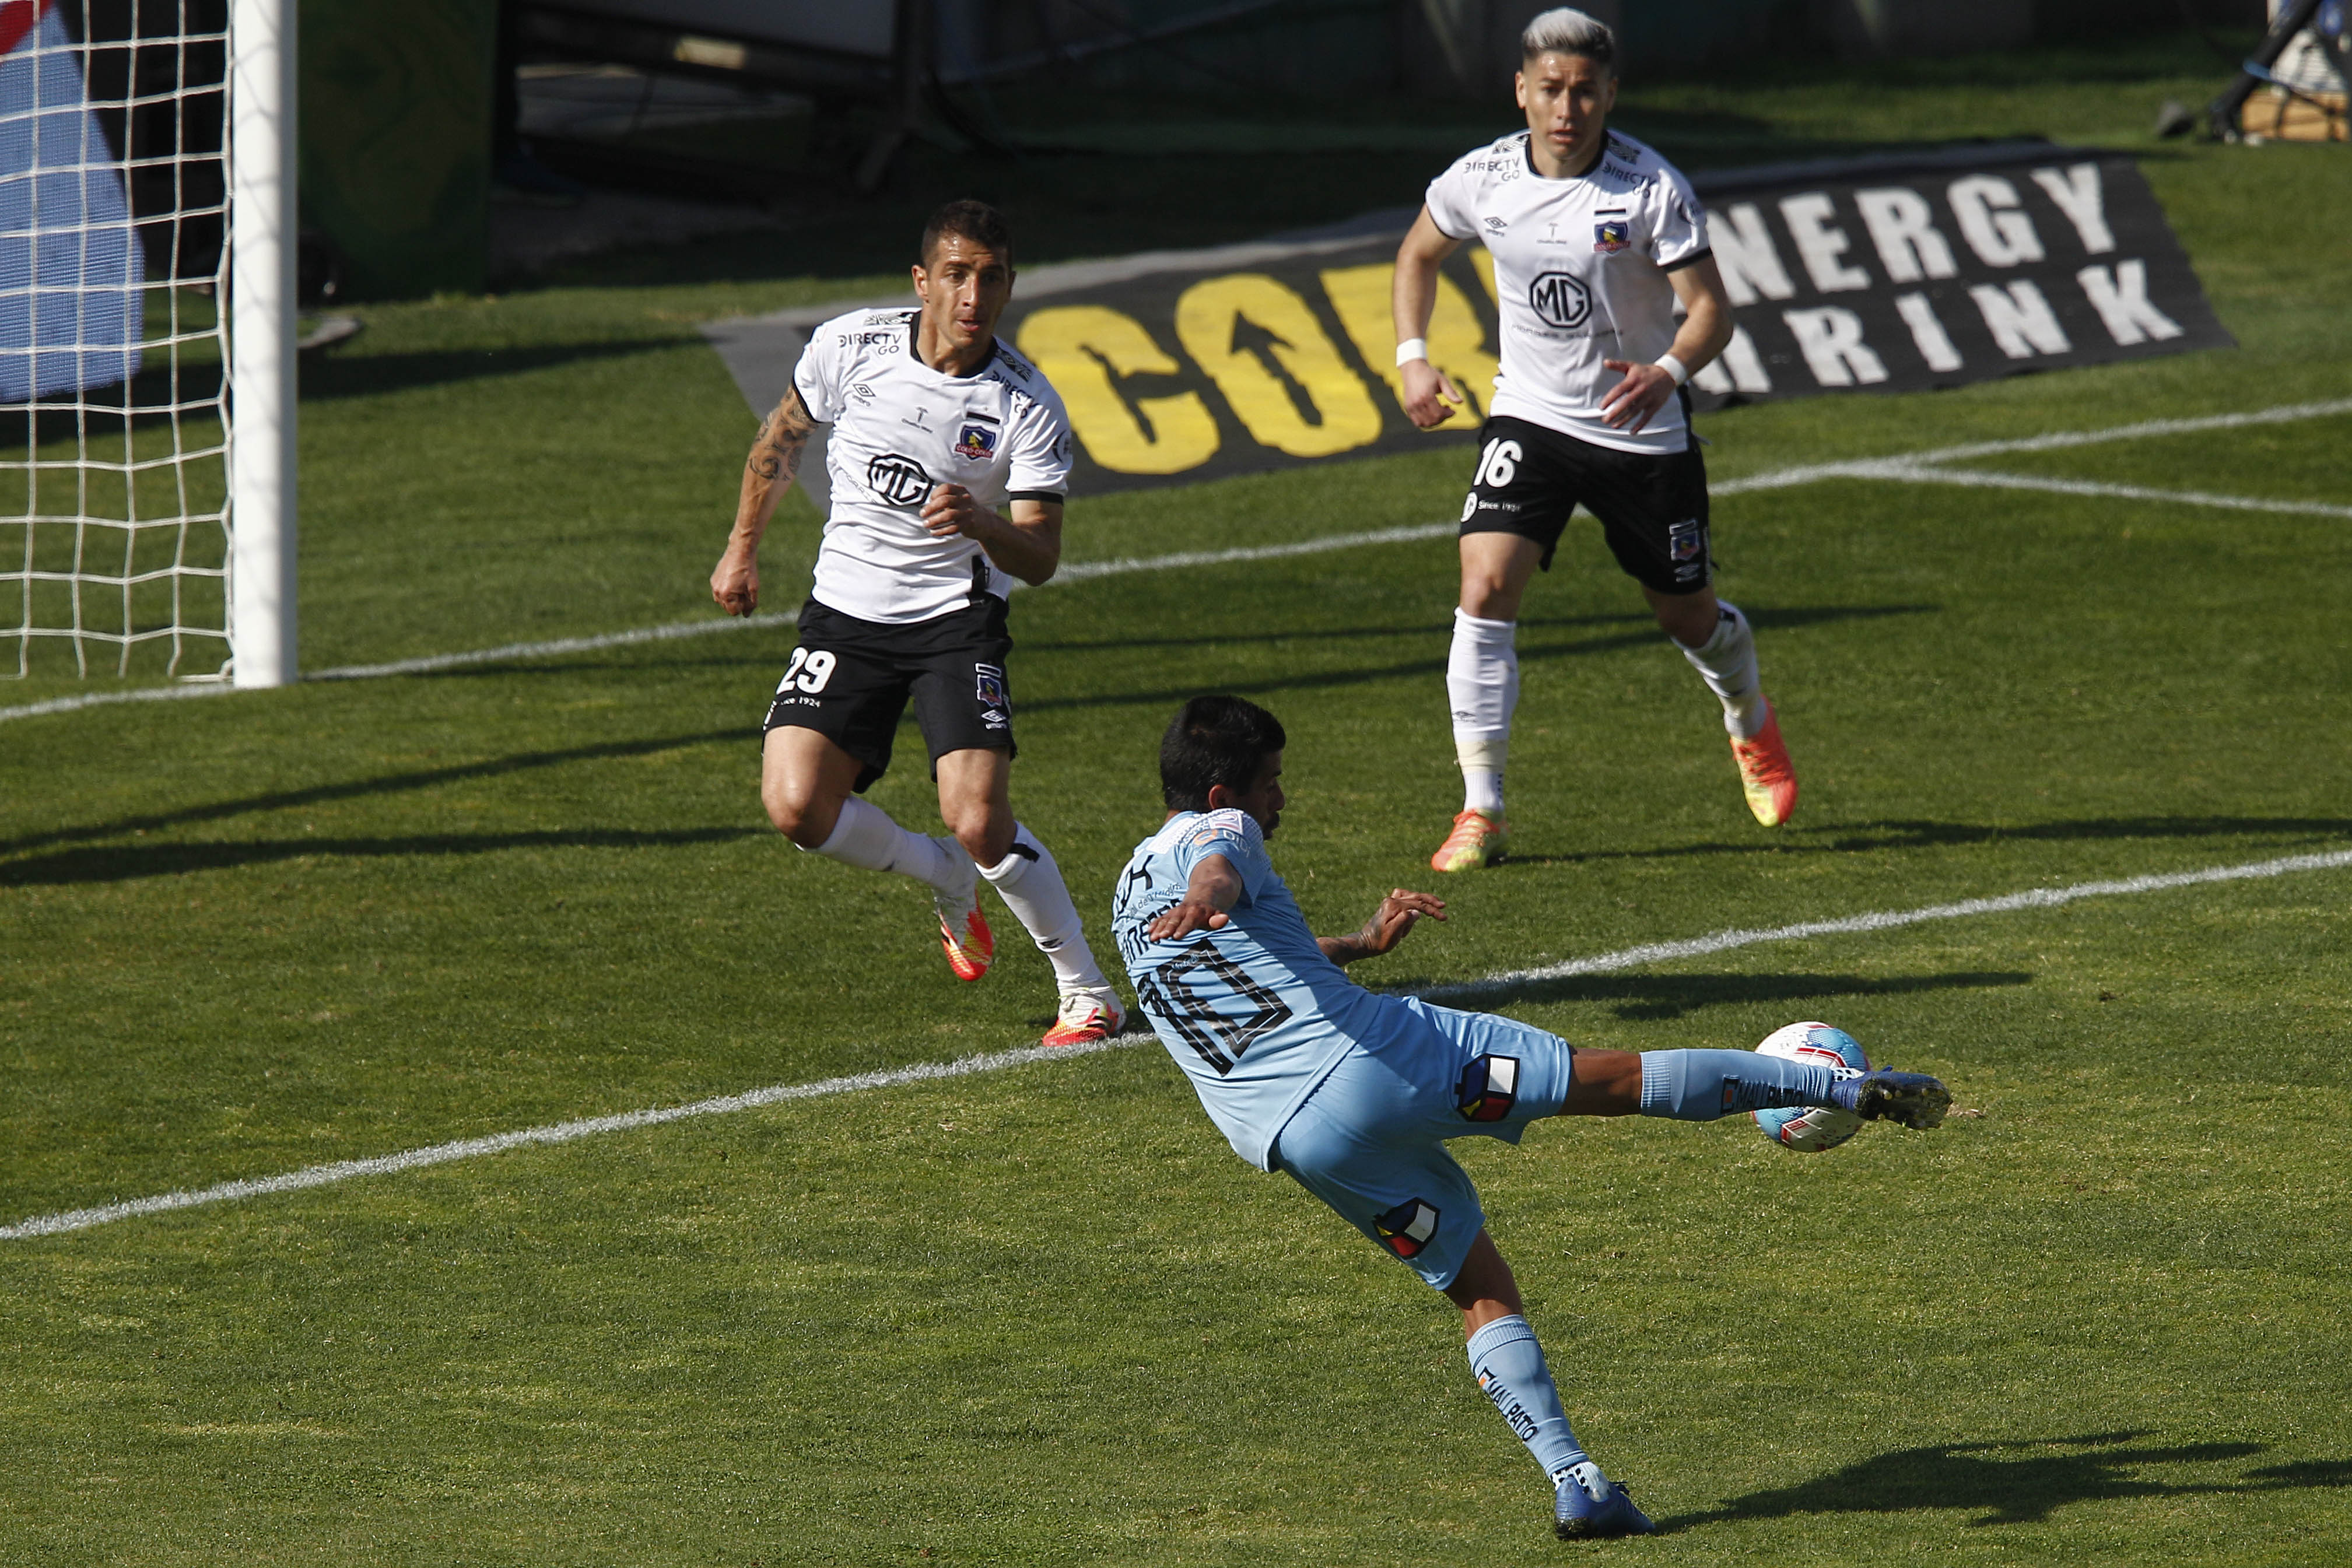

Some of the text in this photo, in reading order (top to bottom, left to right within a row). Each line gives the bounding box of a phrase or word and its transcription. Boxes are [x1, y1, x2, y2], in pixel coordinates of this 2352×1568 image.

[1464, 157, 1520, 173] DIRECTV
[1502, 170, 1520, 181] GO
[1671, 162, 2116, 315] NERGY
[1536, 278, 1586, 322] MG
[837, 332, 902, 348] DIRECTV
[878, 345, 899, 355] GO
[1473, 437, 1523, 487] 16
[874, 462, 927, 503] MG
[776, 647, 837, 694] 29
[798, 696, 821, 708] 1924
[1138, 938, 1294, 1078] 10
[1506, 1402, 1539, 1442] PATIO
